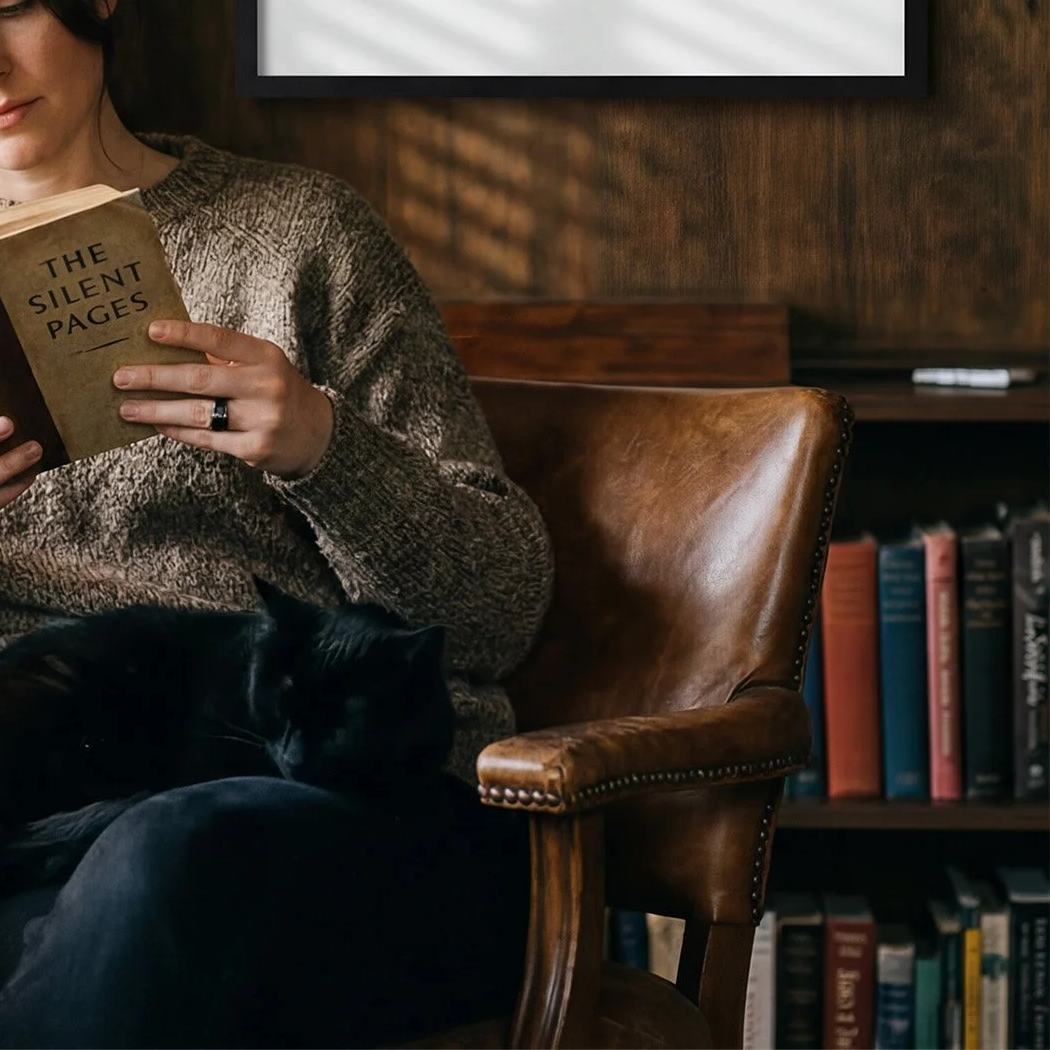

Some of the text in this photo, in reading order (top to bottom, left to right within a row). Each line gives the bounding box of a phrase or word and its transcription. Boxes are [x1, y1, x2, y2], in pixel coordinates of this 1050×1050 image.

[38, 242, 108, 279] THE
[28, 261, 141, 315] SILENT
[46, 291, 149, 340] PAGES
